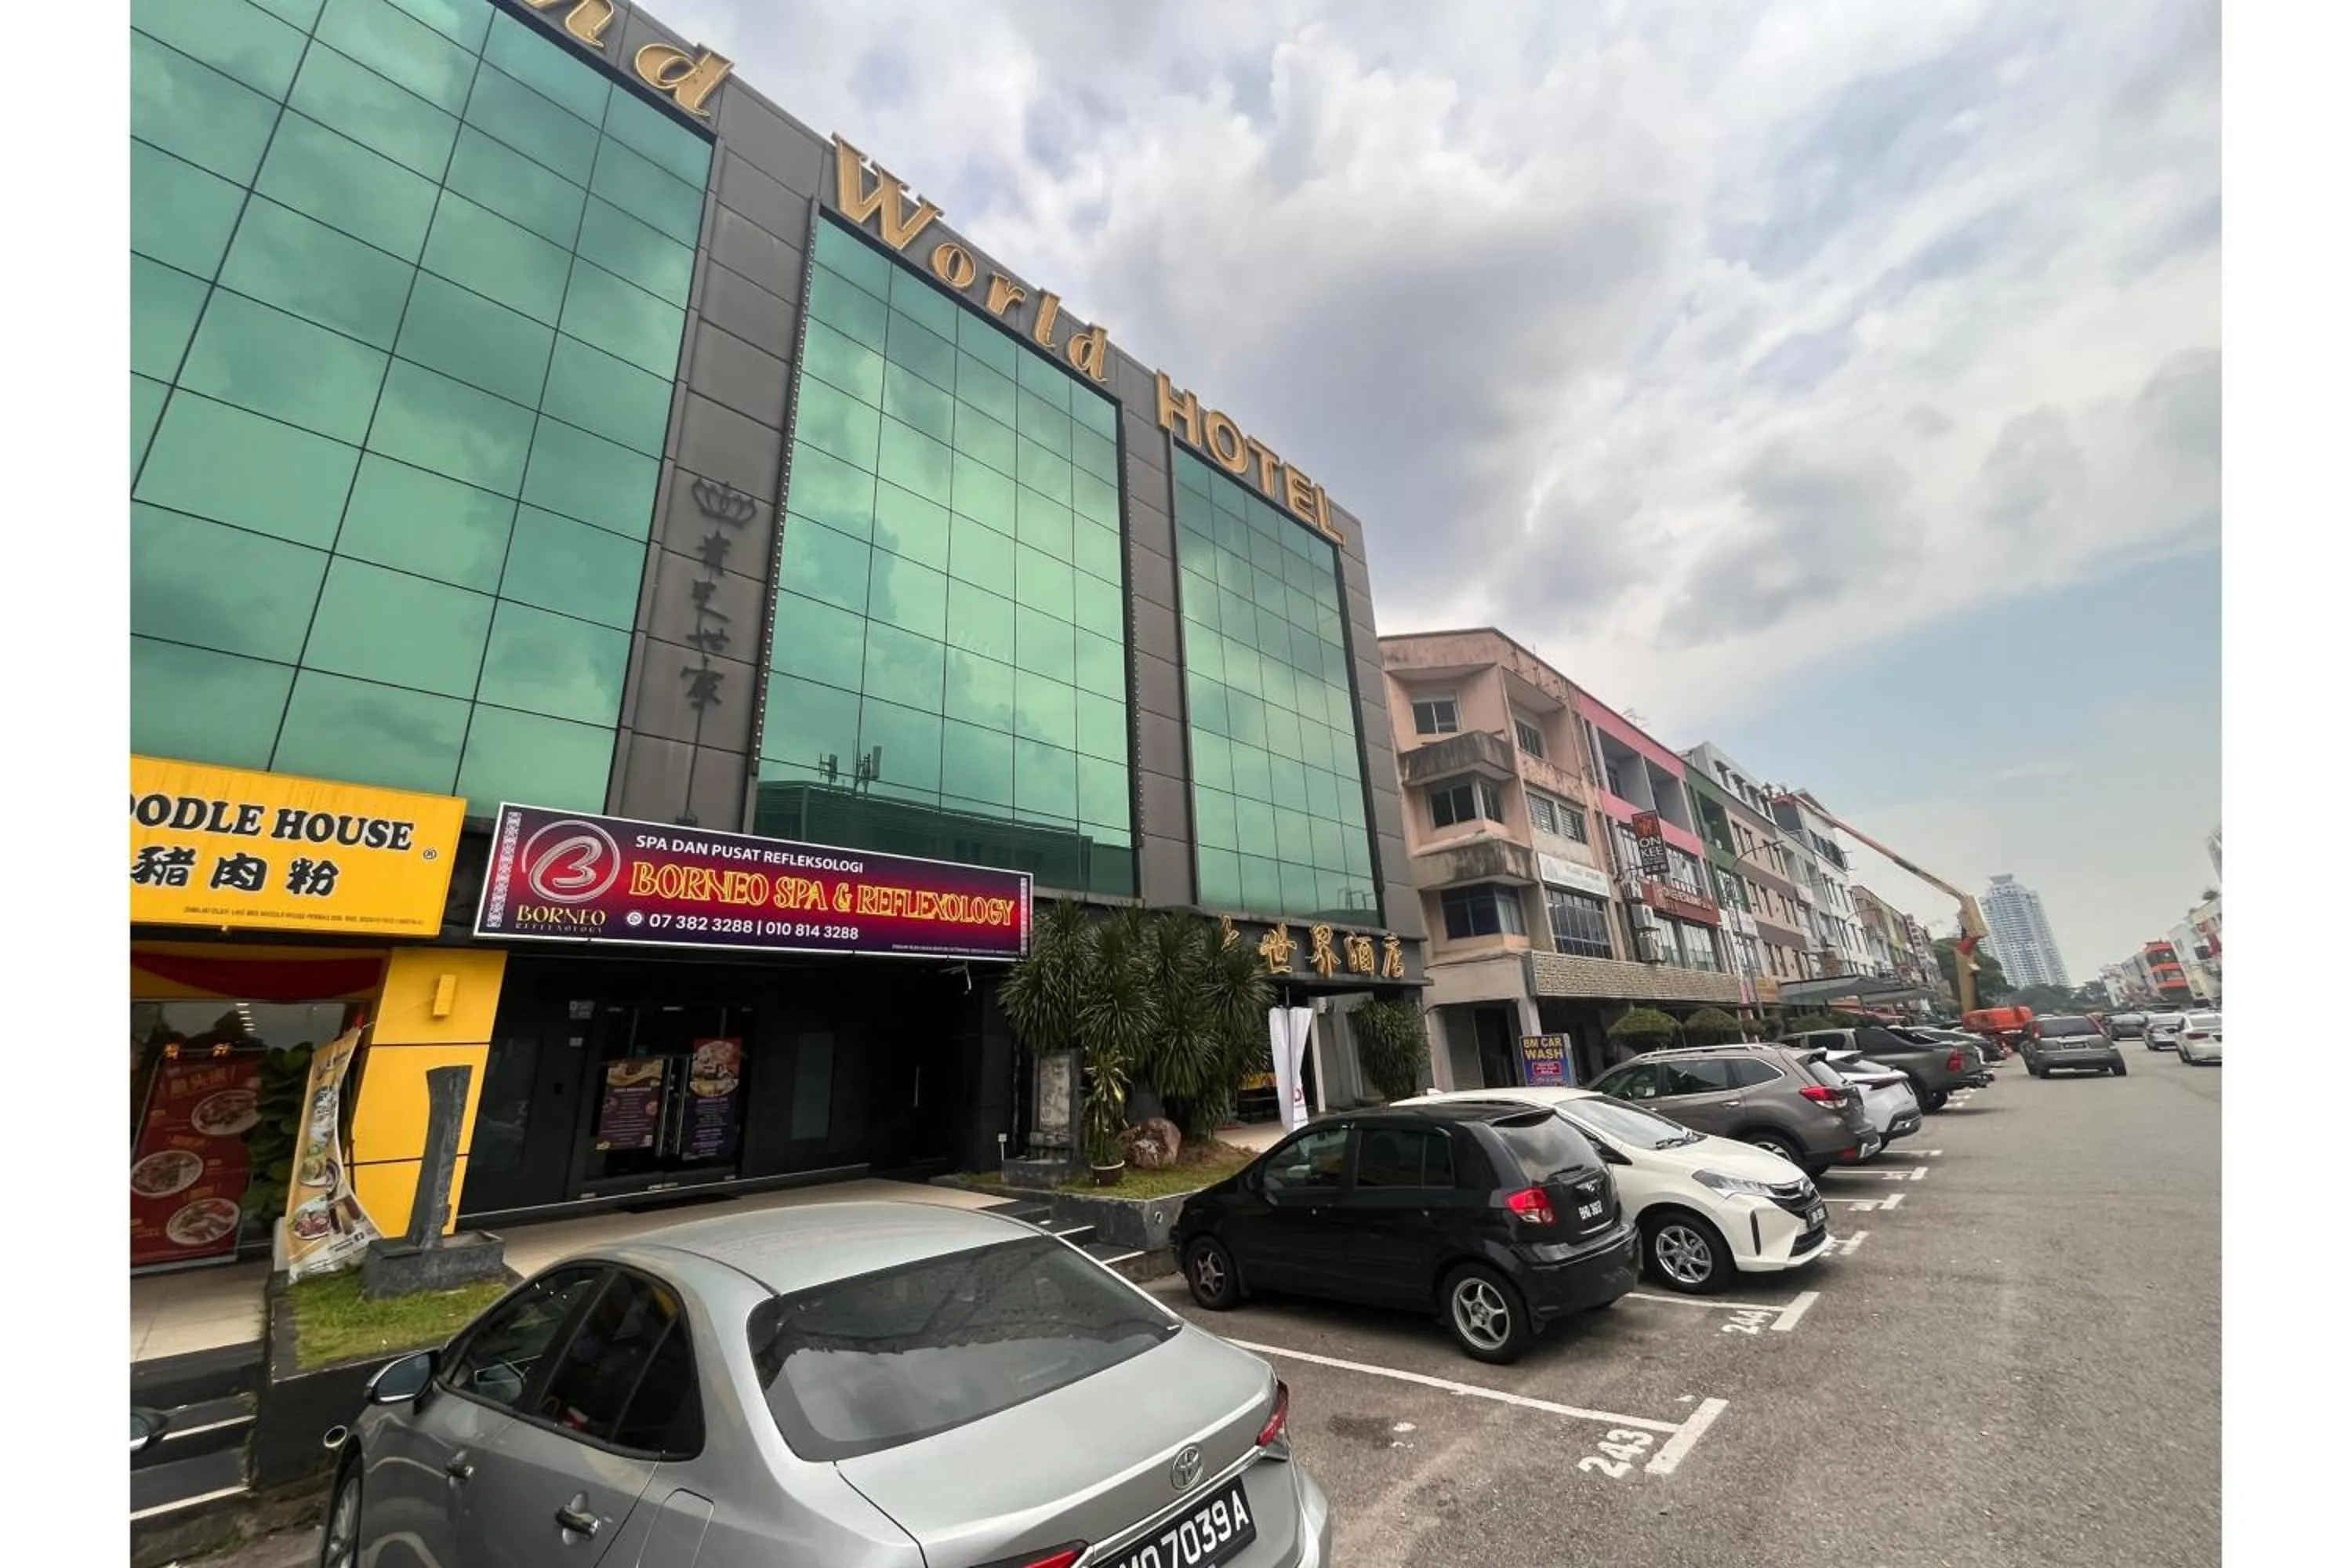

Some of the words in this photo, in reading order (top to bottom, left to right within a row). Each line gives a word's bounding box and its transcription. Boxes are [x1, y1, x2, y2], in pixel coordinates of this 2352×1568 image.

[831, 132, 1108, 383] World
[1156, 369, 1345, 546] HOTEL
[130, 793, 264, 836] ODLE
[271, 808, 414, 850] HOUSE
[636, 835, 667, 851] SPA
[672, 840, 708, 855] DAN
[712, 844, 760, 861] PUSAT
[764, 851, 863, 873] REFLEKSOLOGI
[629, 862, 769, 906] BORNEO
[773, 876, 828, 910] SPA
[833, 883, 853, 913] &
[857, 884, 1014, 926] REFLEXOLOGY
[517, 905, 606, 926] BORNEO
[649, 913, 672, 927] 07
[676, 916, 708, 931] 382
[712, 918, 753, 934] 3288
[766, 922, 791, 935] 010
[795, 924, 820, 938] 814
[824, 926, 858, 940] 3288
[1525, 1048, 1563, 1061] WASH
[1541, 1037, 1563, 1047] CAR
[1577, 1429, 1653, 1478] 243
